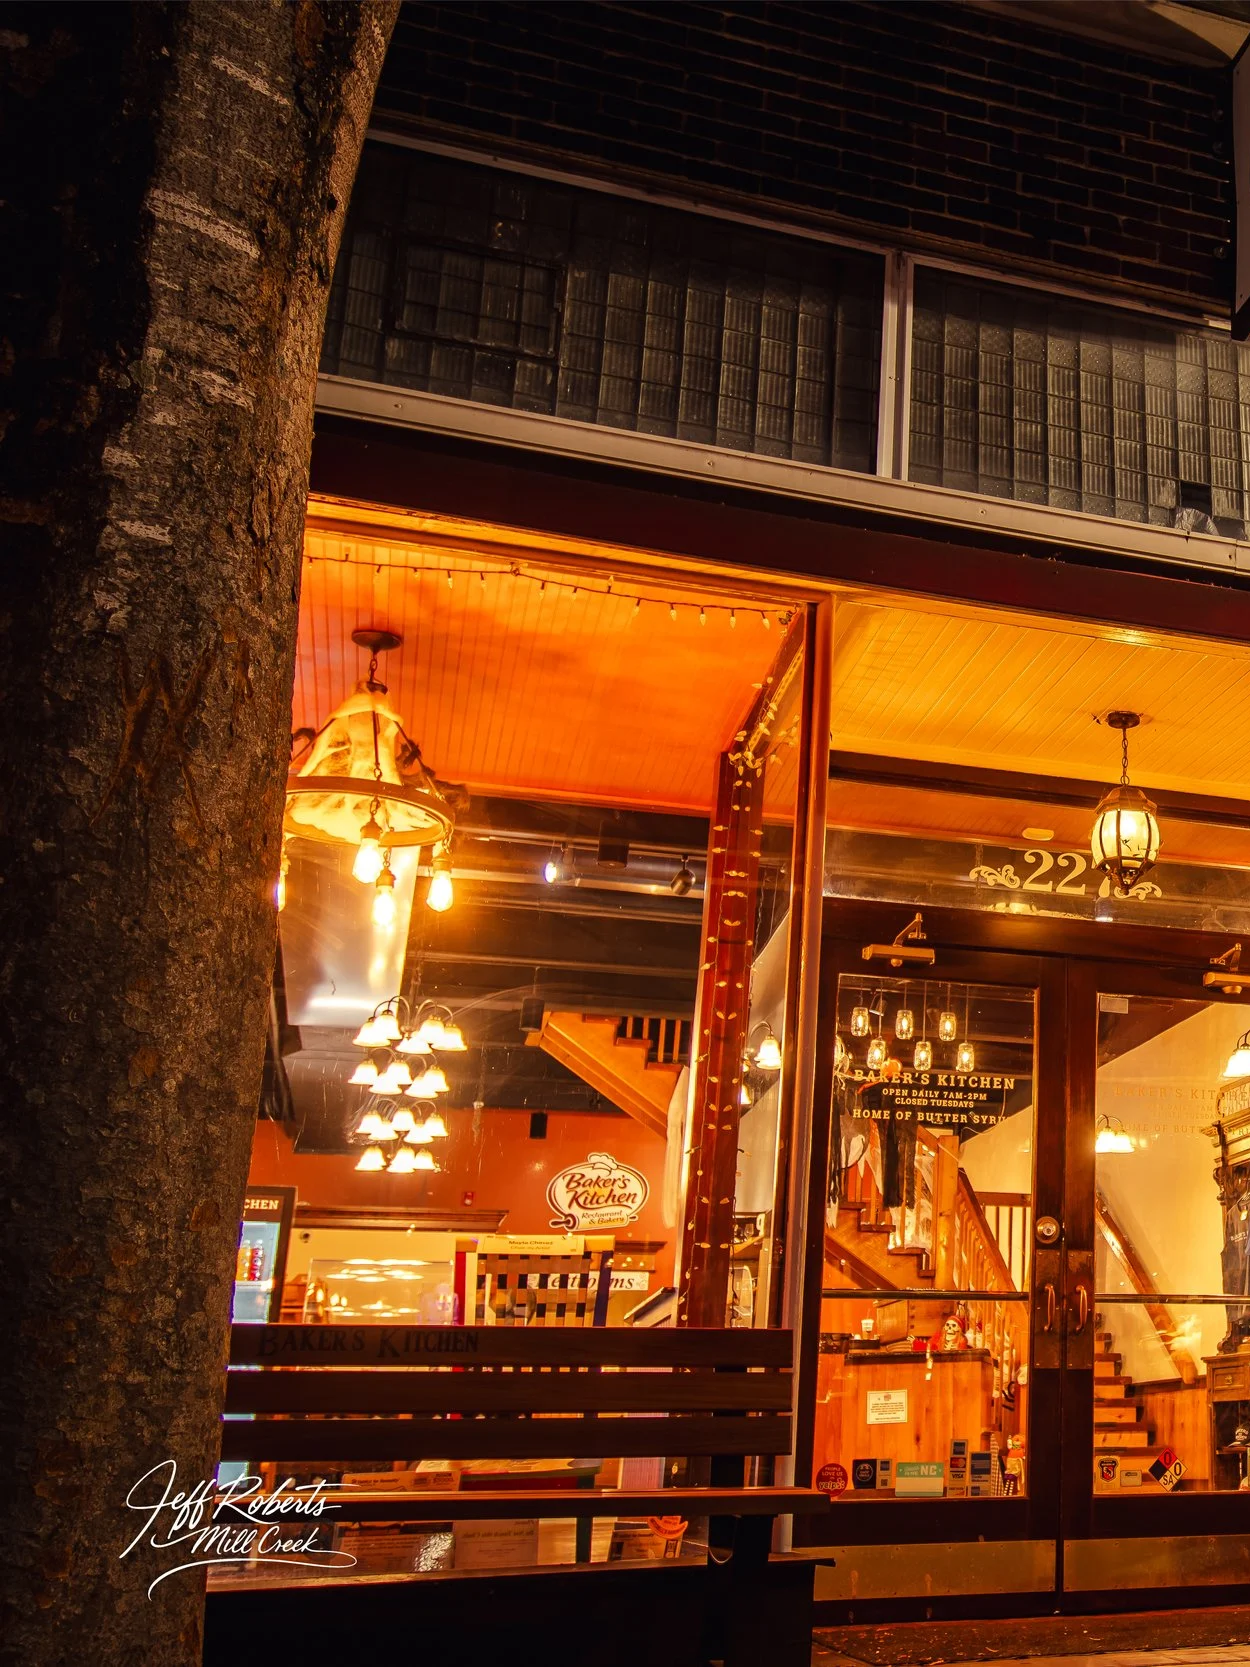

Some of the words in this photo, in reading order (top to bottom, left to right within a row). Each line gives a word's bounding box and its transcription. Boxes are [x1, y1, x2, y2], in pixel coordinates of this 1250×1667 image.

[854, 1069, 930, 1085] BAKER'S
[938, 1075, 1016, 1090] KITCHEN
[882, 1088, 908, 1097] OPEN
[912, 1090, 939, 1099] DAILY
[943, 1091, 987, 1100] 7AM-2PM
[895, 1098, 928, 1106] CLOSED
[931, 1099, 974, 1108] TUESDAYS
[853, 1109, 891, 1120] HOME
[896, 1111, 912, 1121] OF
[917, 1112, 968, 1124] BUTTER
[972, 1114, 1011, 1126] SYRU
[562, 1172, 631, 1190] Baker's
[565, 1188, 638, 1210] Kitchen
[581, 1210, 623, 1219] Restaurant
[597, 1217, 625, 1225] Bakery
[257, 1326, 366, 1358] BAKER'S
[377, 1326, 480, 1358] KITCHEN
[921, 1465, 937, 1475] NC
[1162, 1474, 1175, 1486] SA
